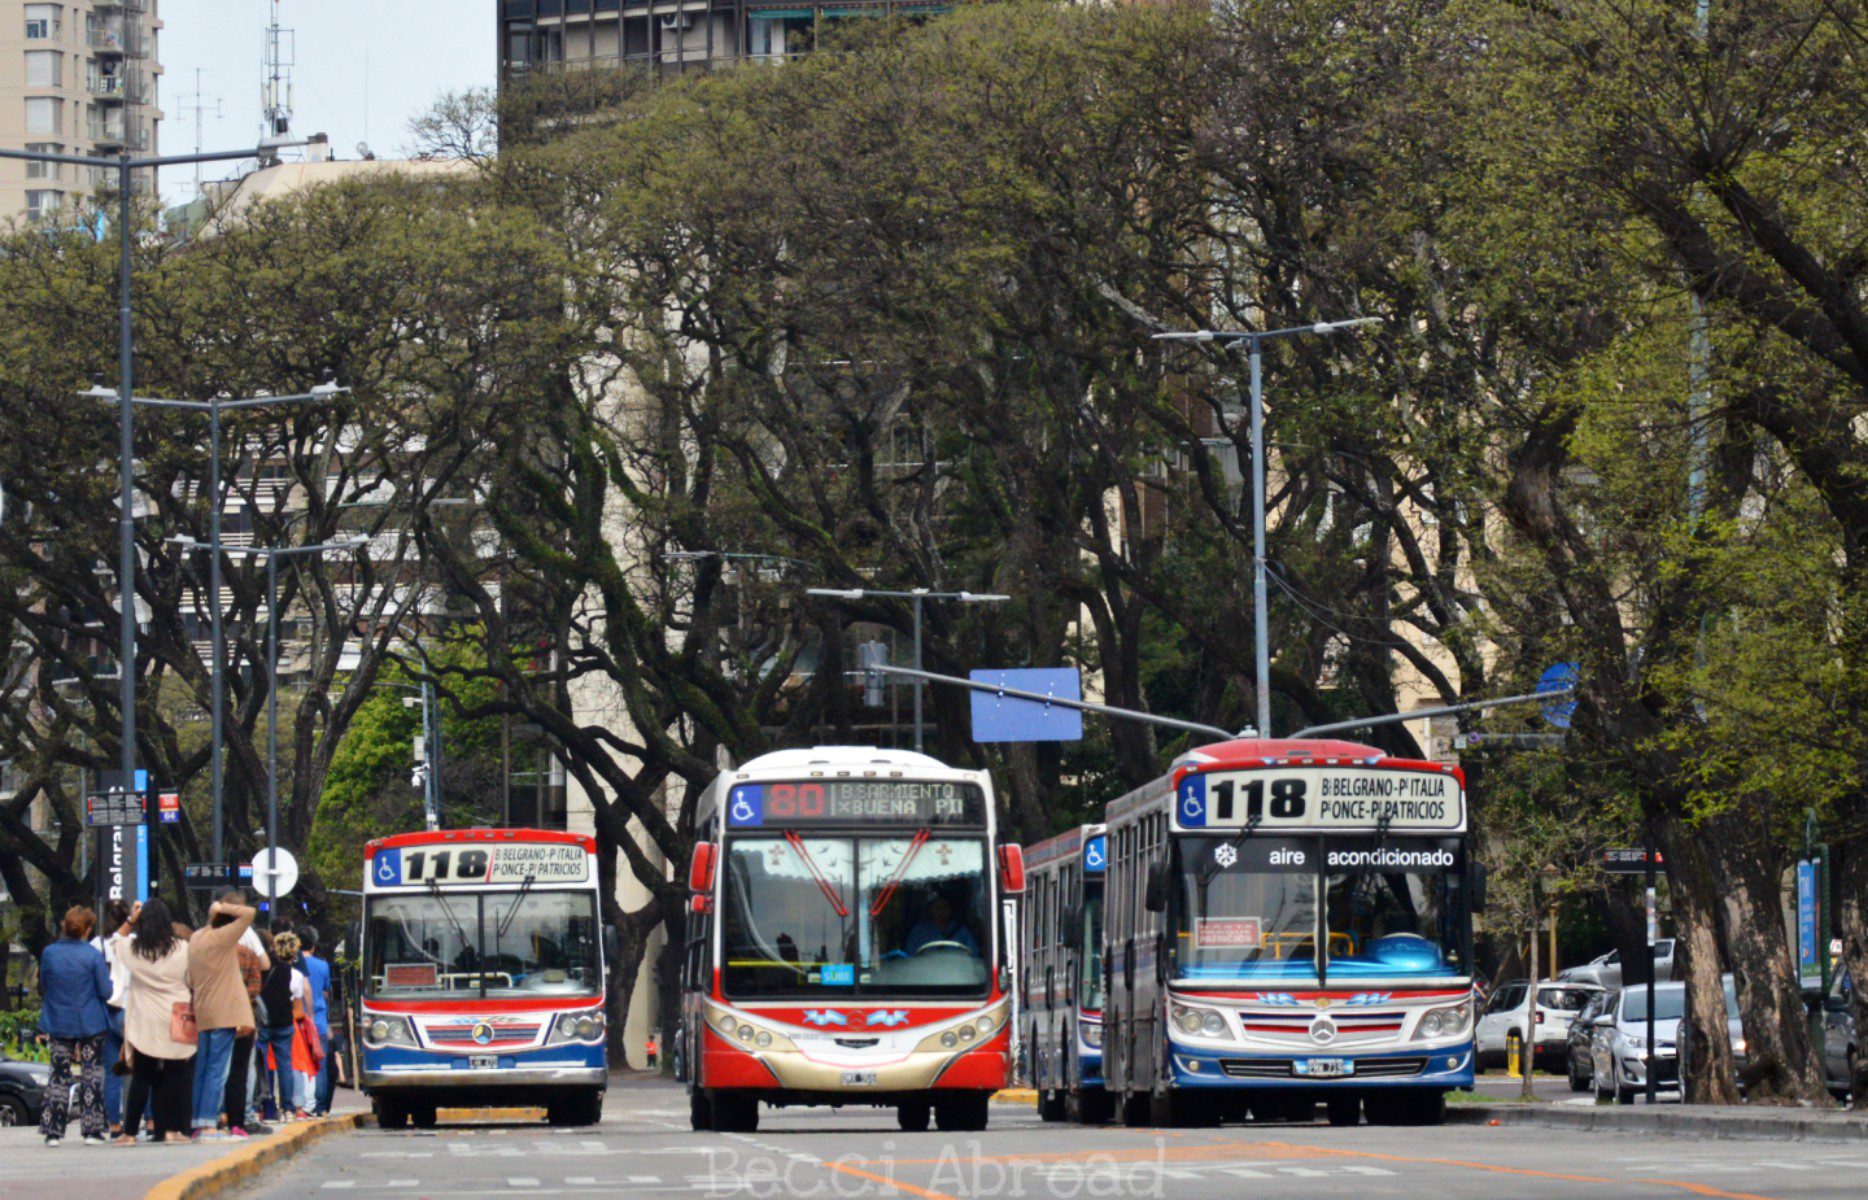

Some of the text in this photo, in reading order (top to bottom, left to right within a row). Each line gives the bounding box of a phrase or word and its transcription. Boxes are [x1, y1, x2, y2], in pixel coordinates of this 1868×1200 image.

[1410, 778, 1445, 797] ITALIA
[770, 783, 824, 816] 80
[1211, 778, 1307, 819] 118
[1384, 801, 1445, 819] PATRICIOS
[557, 848, 582, 861] ITALIA
[1269, 848, 1454, 866] aire acondicionado
[405, 849, 488, 881] 118
[537, 862, 581, 876] PATRICIOS
